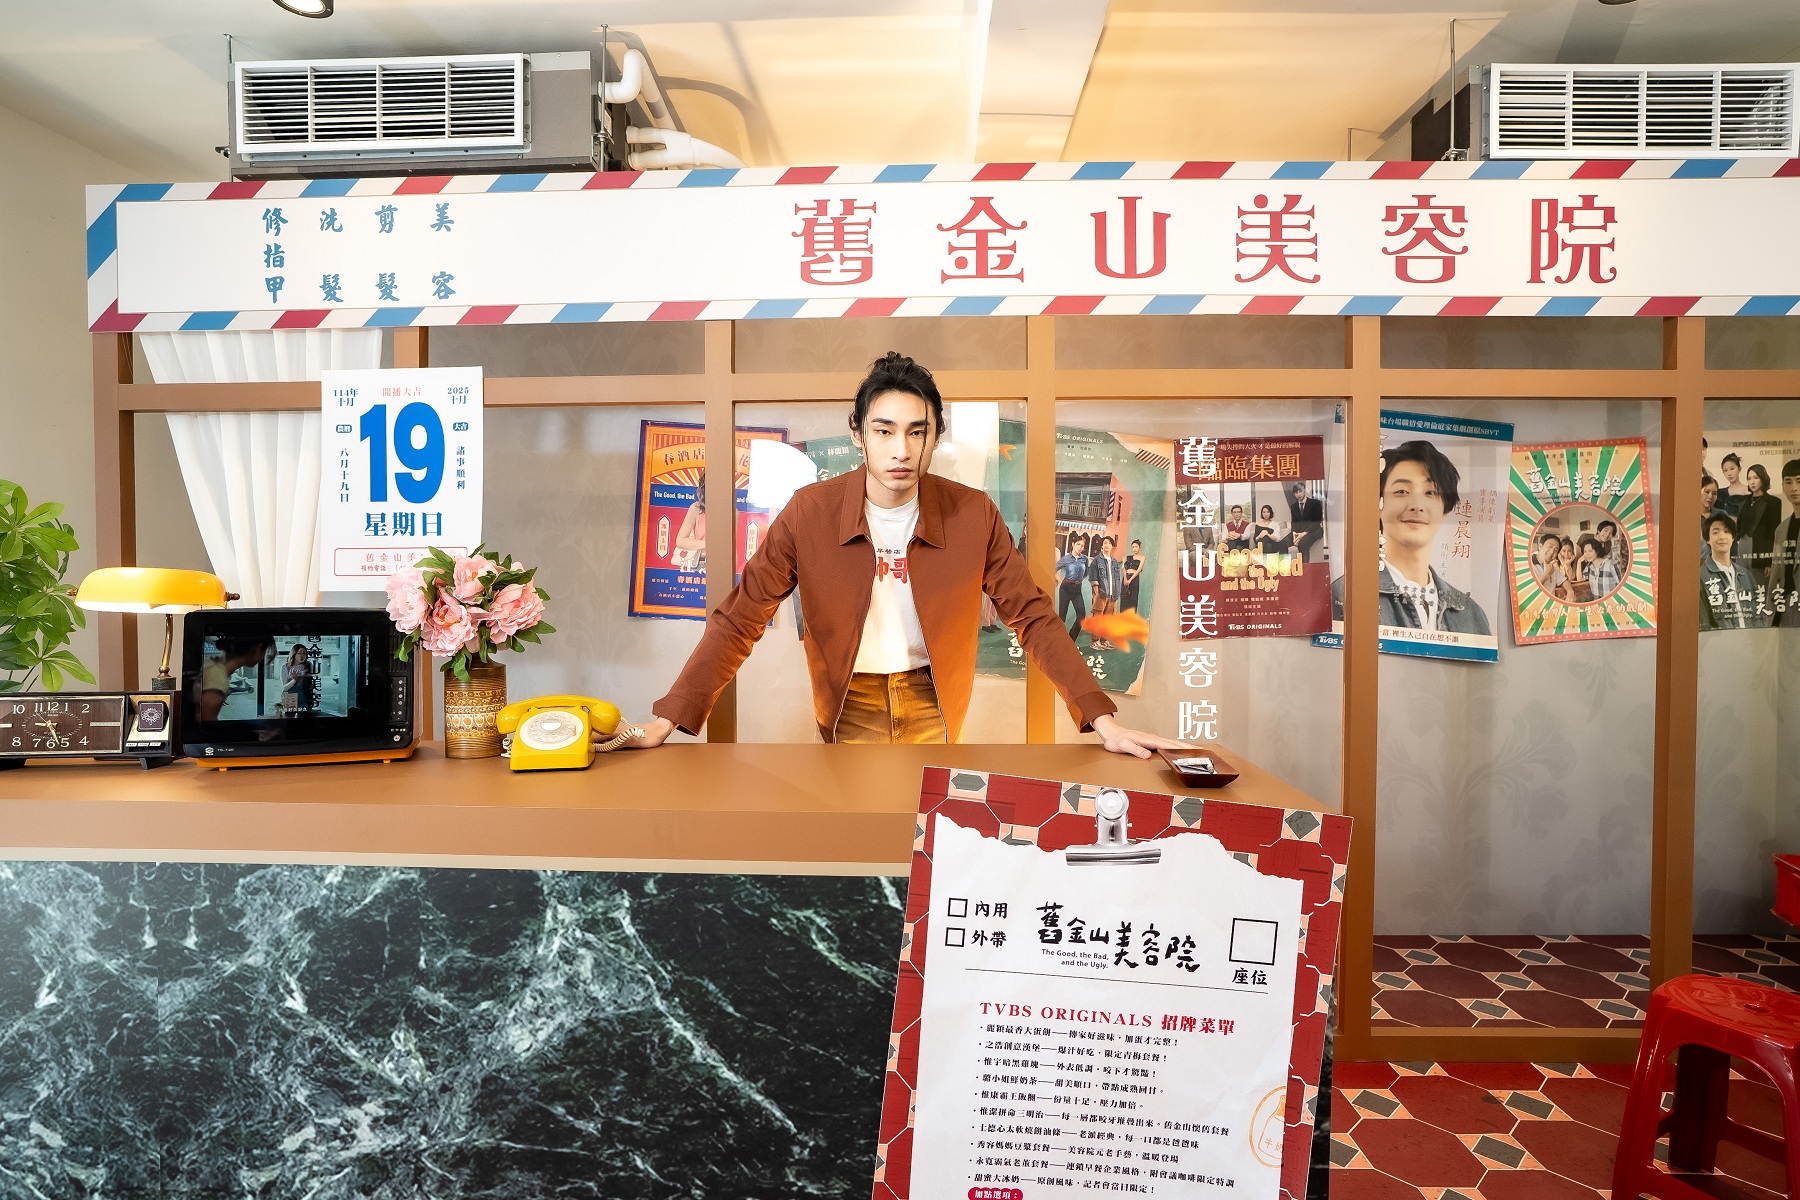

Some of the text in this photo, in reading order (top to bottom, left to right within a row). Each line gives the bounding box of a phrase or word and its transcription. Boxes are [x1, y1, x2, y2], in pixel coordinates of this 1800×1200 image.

[791, 194, 1618, 286] 舊金山美容院
[262, 207, 289, 304] 修指甲
[319, 208, 344, 303] 洗髮
[375, 204, 400, 301] 剪髮
[430, 203, 456, 300] 美容
[333, 388, 358, 398] 114年
[382, 387, 422, 397] 開播大吉
[447, 386, 470, 395] 2025
[337, 397, 354, 407] 十月
[450, 395, 467, 405] 十月
[453, 422, 469, 431] 大吉
[359, 401, 446, 504] 19
[339, 448, 350, 503] 八月十九日
[456, 445, 466, 490] 諸事順利
[364, 511, 443, 537] 星期日
[366, 552, 424, 563] 舊金山美
[1177, 436, 1220, 741] 舊金山美容院
[1220, 577, 1279, 592] and the Ugly
[1318, 635, 1338, 645] TVBS
[12, 701, 90, 715] 10 11 12 1 2
[11, 735, 90, 749] 8 7 6 5 4
[975, 900, 1008, 919] 內用
[971, 930, 1007, 949] 外帶
[1036, 901, 1200, 973] 舊金山美容院
[1042, 948, 1109, 961] The Good, the Bad,
[1061, 959, 1109, 970] and the Ugly.
[1231, 968, 1268, 986] 座位
[980, 1002, 1235, 1036] TVBS ORIGINALS 招牌菜單
